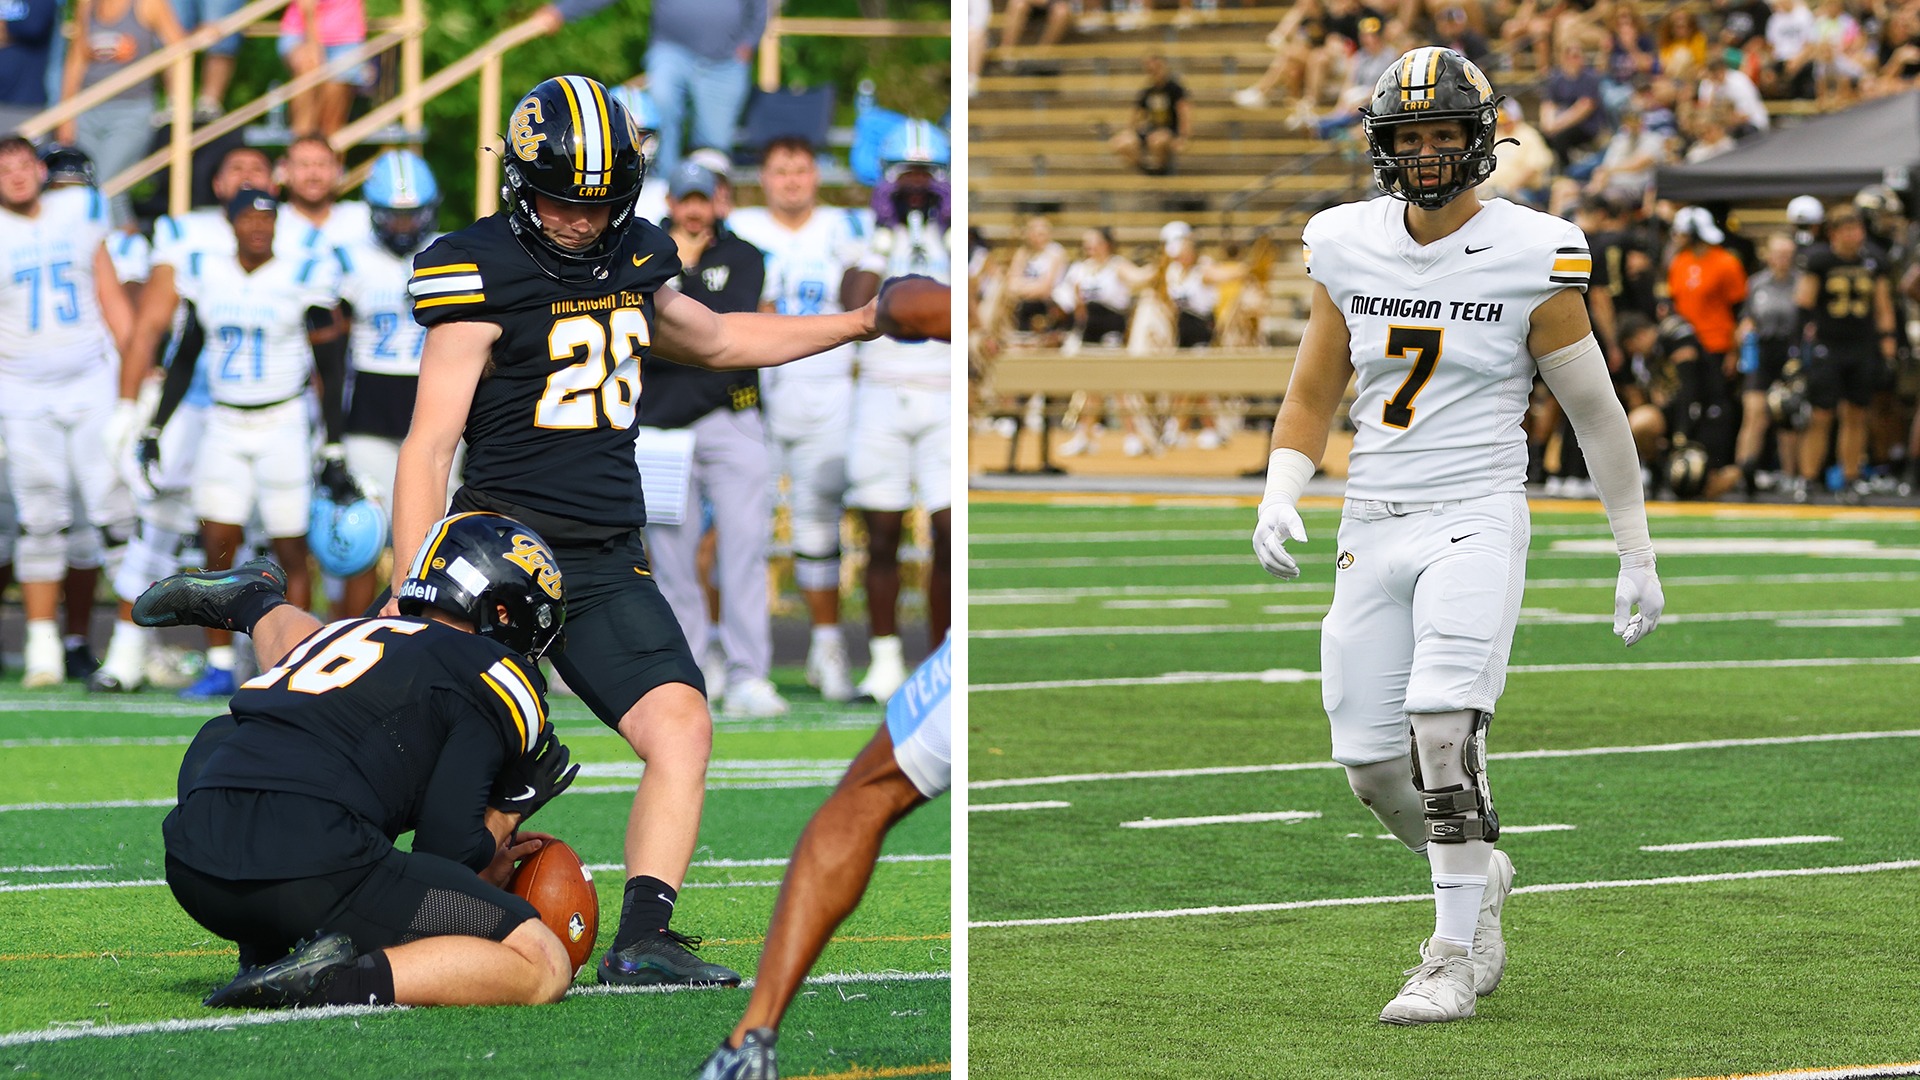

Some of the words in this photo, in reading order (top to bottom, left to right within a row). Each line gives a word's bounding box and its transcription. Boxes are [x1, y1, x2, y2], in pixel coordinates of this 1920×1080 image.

[509, 97, 547, 161] Tech
[1404, 101, 1430, 110] CRTD
[579, 187, 607, 196] CRTD
[13, 261, 81, 330] 75
[1351, 295, 1442, 319] MICHIGAN
[1449, 301, 1503, 322] TECH
[219, 326, 264, 381] 21
[534, 307, 650, 430] 26
[1381, 324, 1445, 430] 7
[502, 534, 562, 600] Tech
[240, 618, 429, 695] 16
